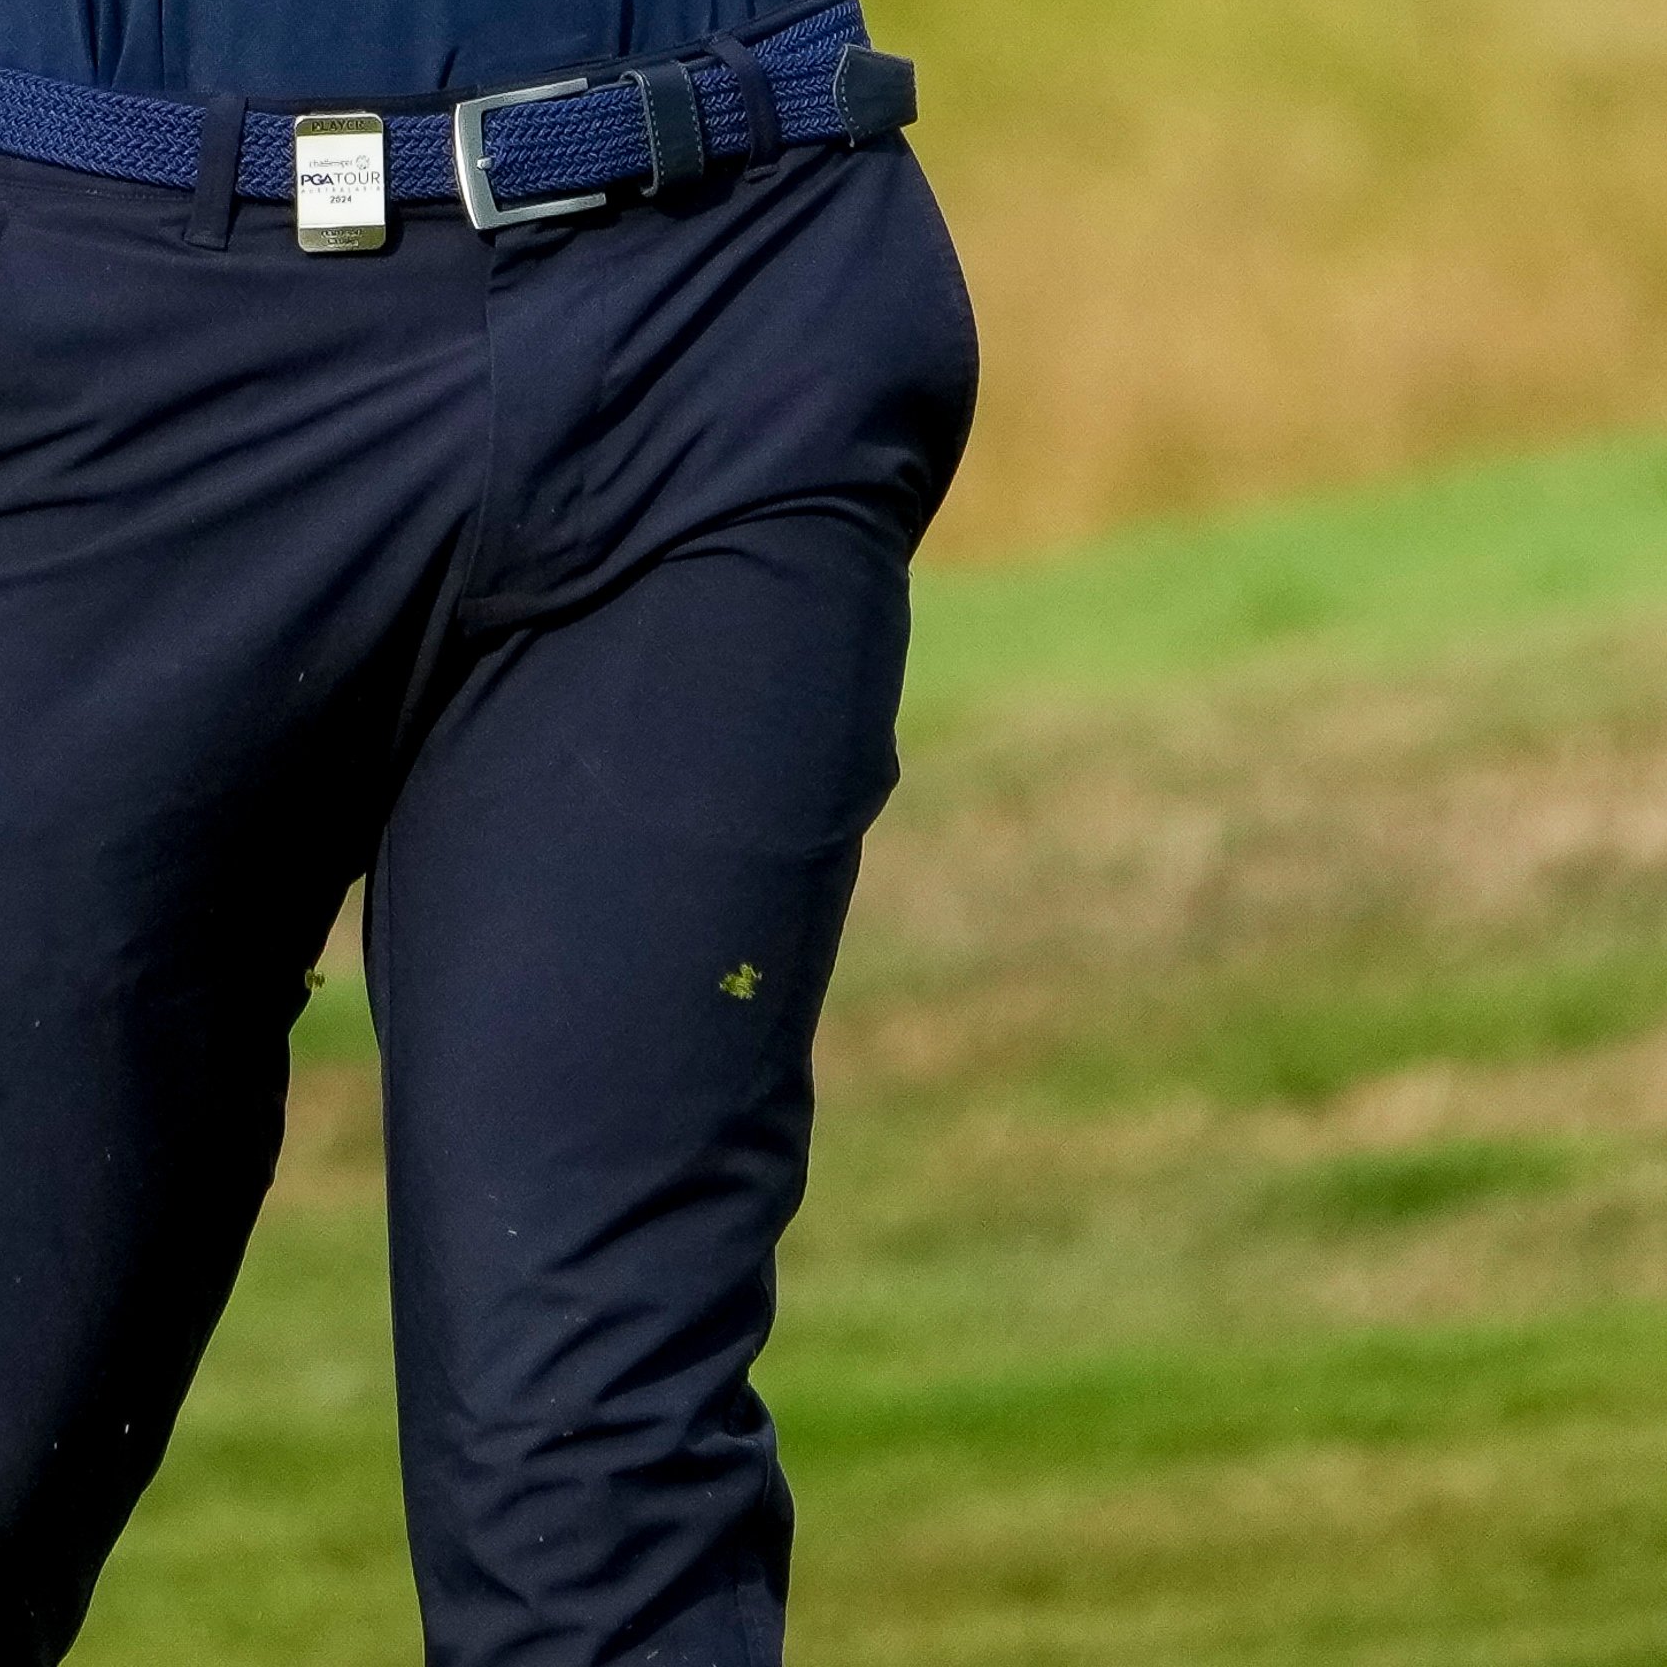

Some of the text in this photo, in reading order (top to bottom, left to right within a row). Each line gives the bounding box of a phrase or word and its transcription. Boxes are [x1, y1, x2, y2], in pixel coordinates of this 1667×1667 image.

[311, 120, 366, 132] PLAYER
[300, 171, 381, 186] PGA TOUR
[329, 195, 352, 204] 2024
